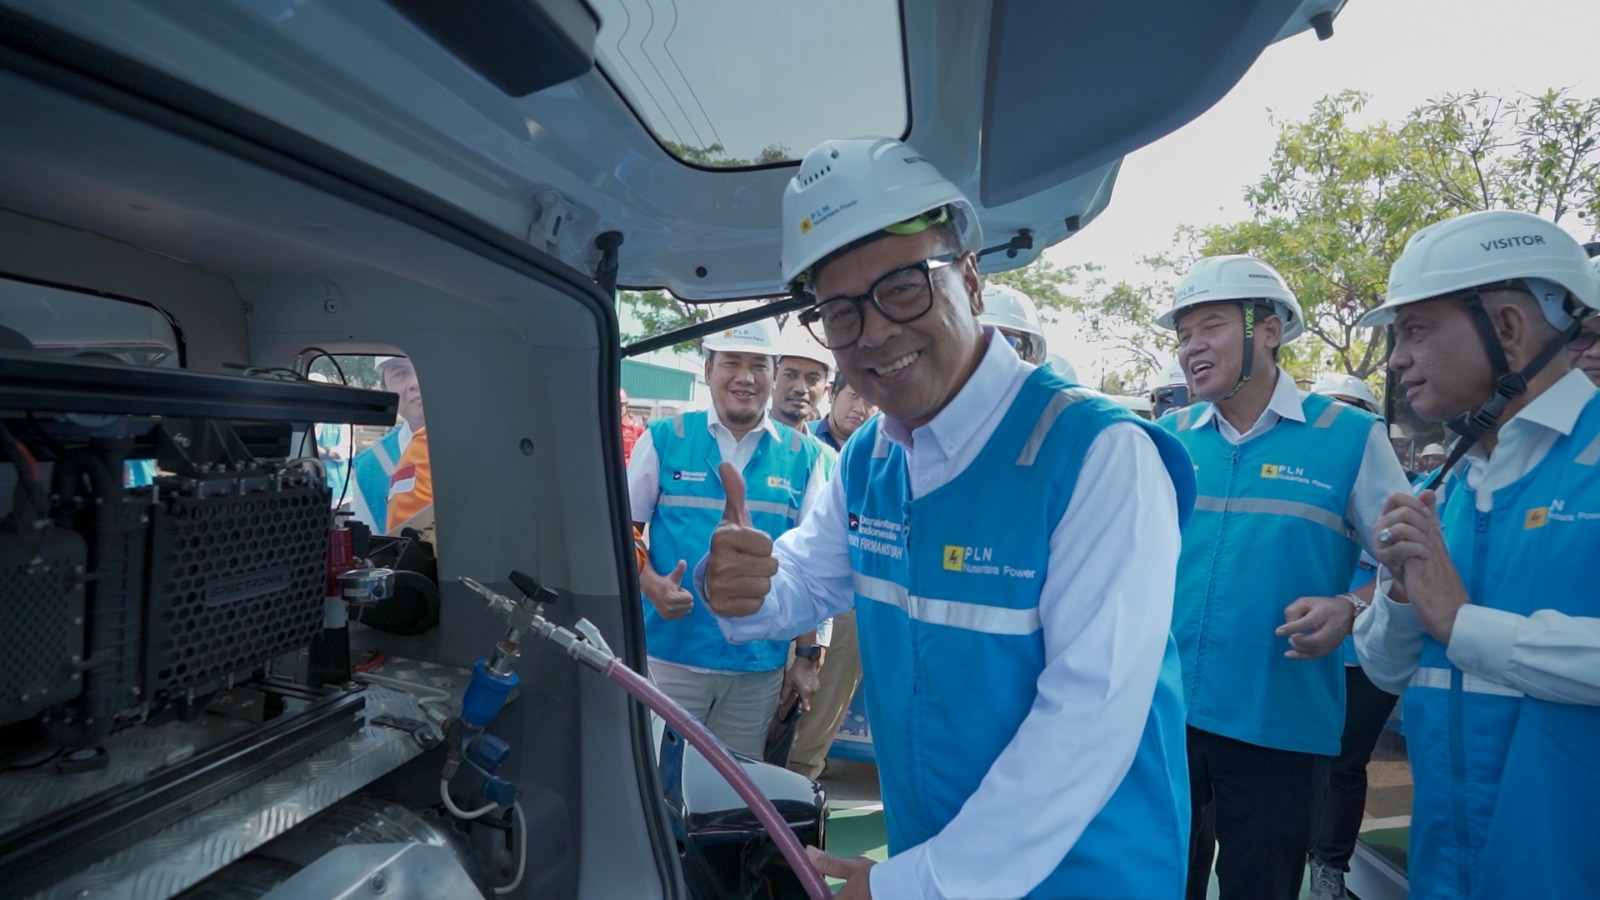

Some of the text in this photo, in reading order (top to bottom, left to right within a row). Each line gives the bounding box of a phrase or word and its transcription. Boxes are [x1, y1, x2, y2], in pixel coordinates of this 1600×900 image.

[810, 204, 830, 220] PLN
[1480, 235, 1546, 252] VISITOR
[1245, 308, 1254, 338] uvex
[1278, 465, 1304, 476] PLN
[859, 514, 901, 532] Danantara
[858, 524, 897, 541] Indonesia
[860, 537, 903, 560] FIRMANSYAH
[964, 546, 993, 561] PLN
[963, 563, 1036, 578] Nusantara Power
